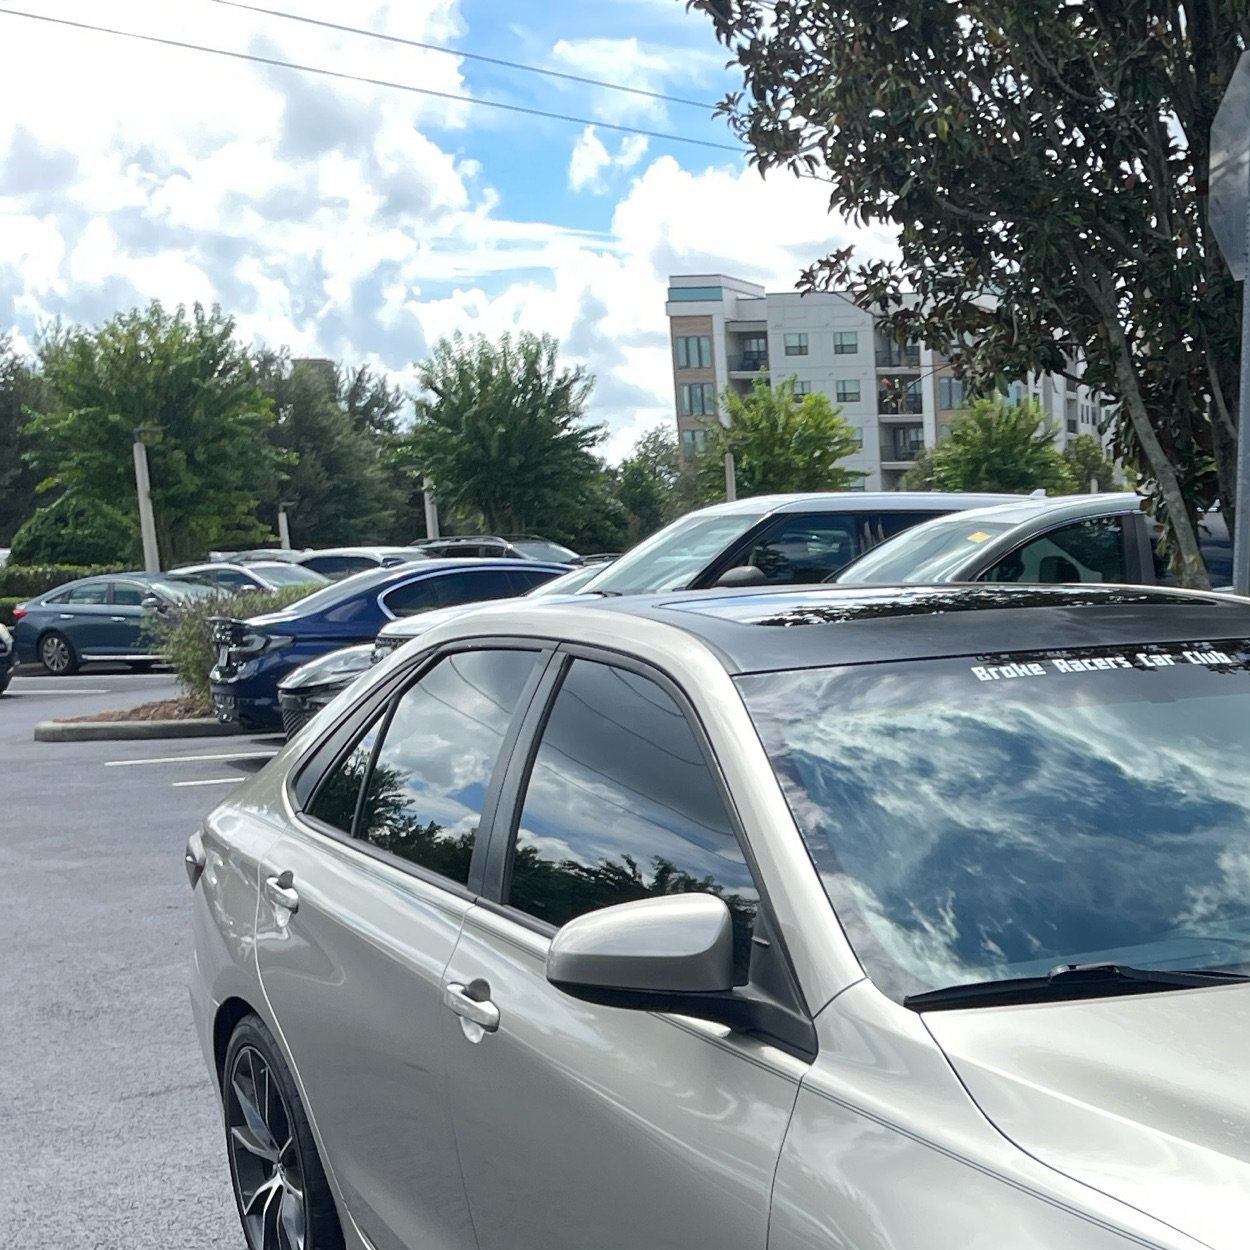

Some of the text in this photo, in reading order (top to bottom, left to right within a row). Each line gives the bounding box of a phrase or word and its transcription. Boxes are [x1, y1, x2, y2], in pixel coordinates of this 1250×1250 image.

[971, 651, 1232, 681] Broke Racers Car Club
